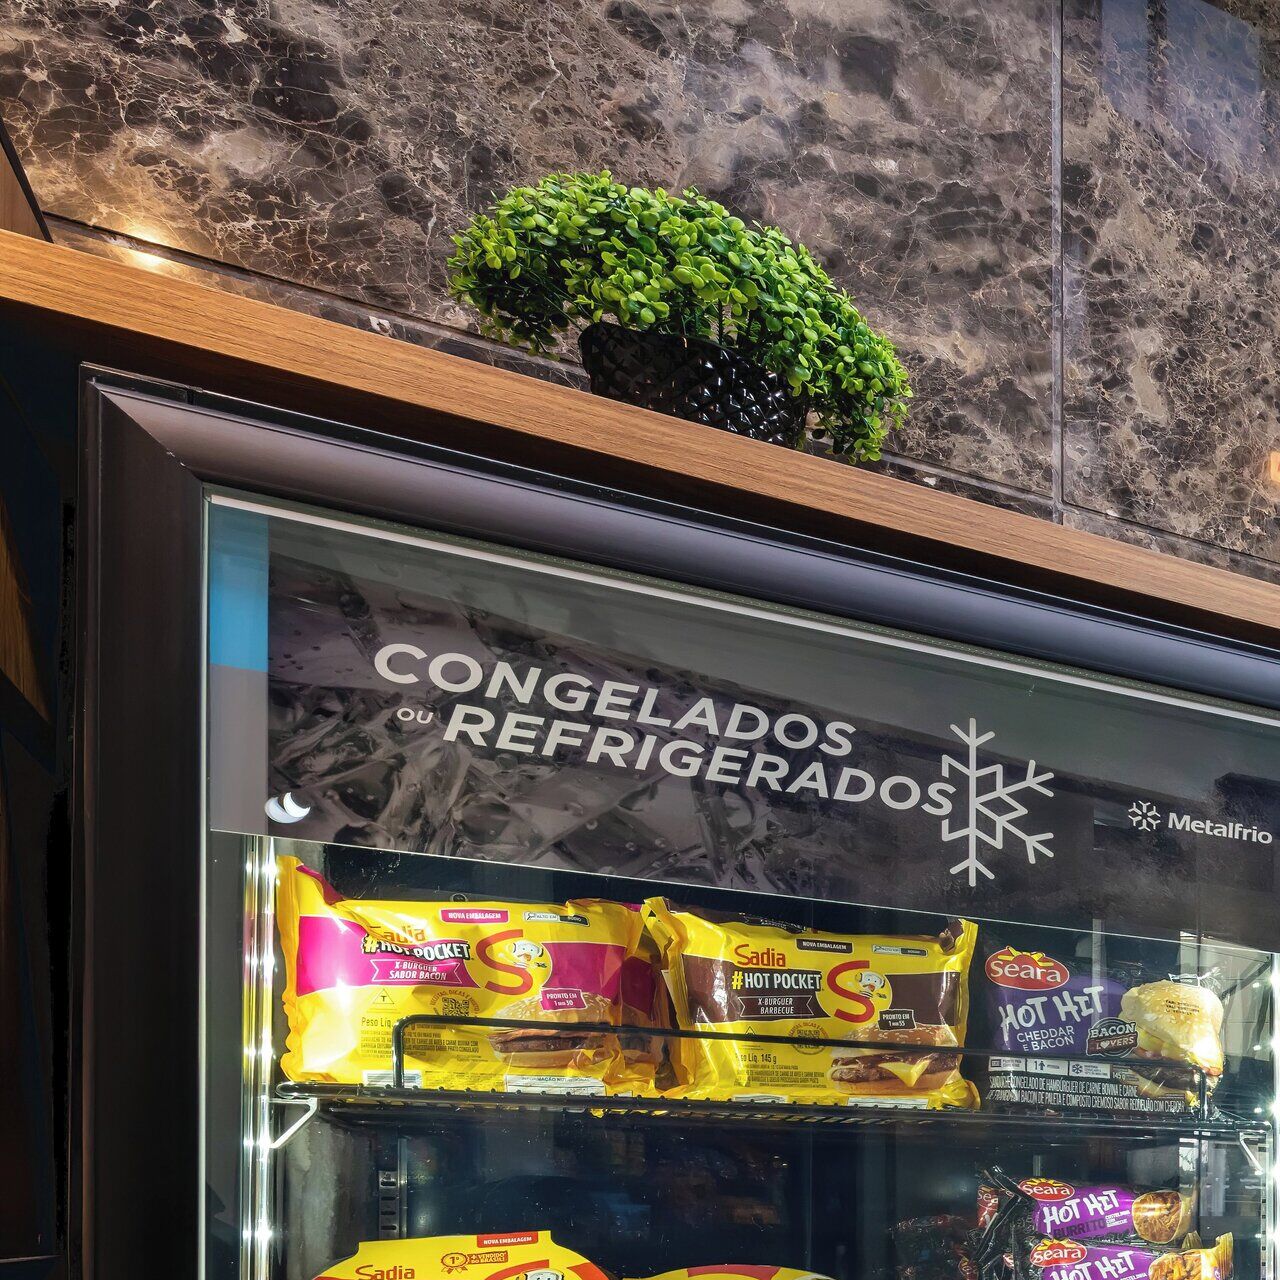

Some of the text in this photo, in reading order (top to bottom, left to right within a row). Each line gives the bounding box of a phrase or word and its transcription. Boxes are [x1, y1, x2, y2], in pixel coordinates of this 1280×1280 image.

[375, 643, 856, 758] CONGELADOS
[396, 705, 955, 818] OU REFRIGERADOS
[1167, 811, 1273, 845] Metalfrio
[734, 944, 786, 968] Sadia
[389, 970, 447, 981] SABOR BACON
[731, 970, 821, 991] #HOT POCKET
[990, 959, 1062, 983] Seara
[757, 997, 793, 1006] X-BURGUER
[760, 1006, 794, 1016] BARBECUE
[998, 985, 1104, 1043] HOT HIT
[1016, 1025, 1075, 1043] CHEDDAR
[1089, 1021, 1136, 1039] BACON
[1033, 1036, 1075, 1052] BACON
[1043, 1198, 1080, 1233] HOT
[1033, 1247, 1082, 1263] Seara
